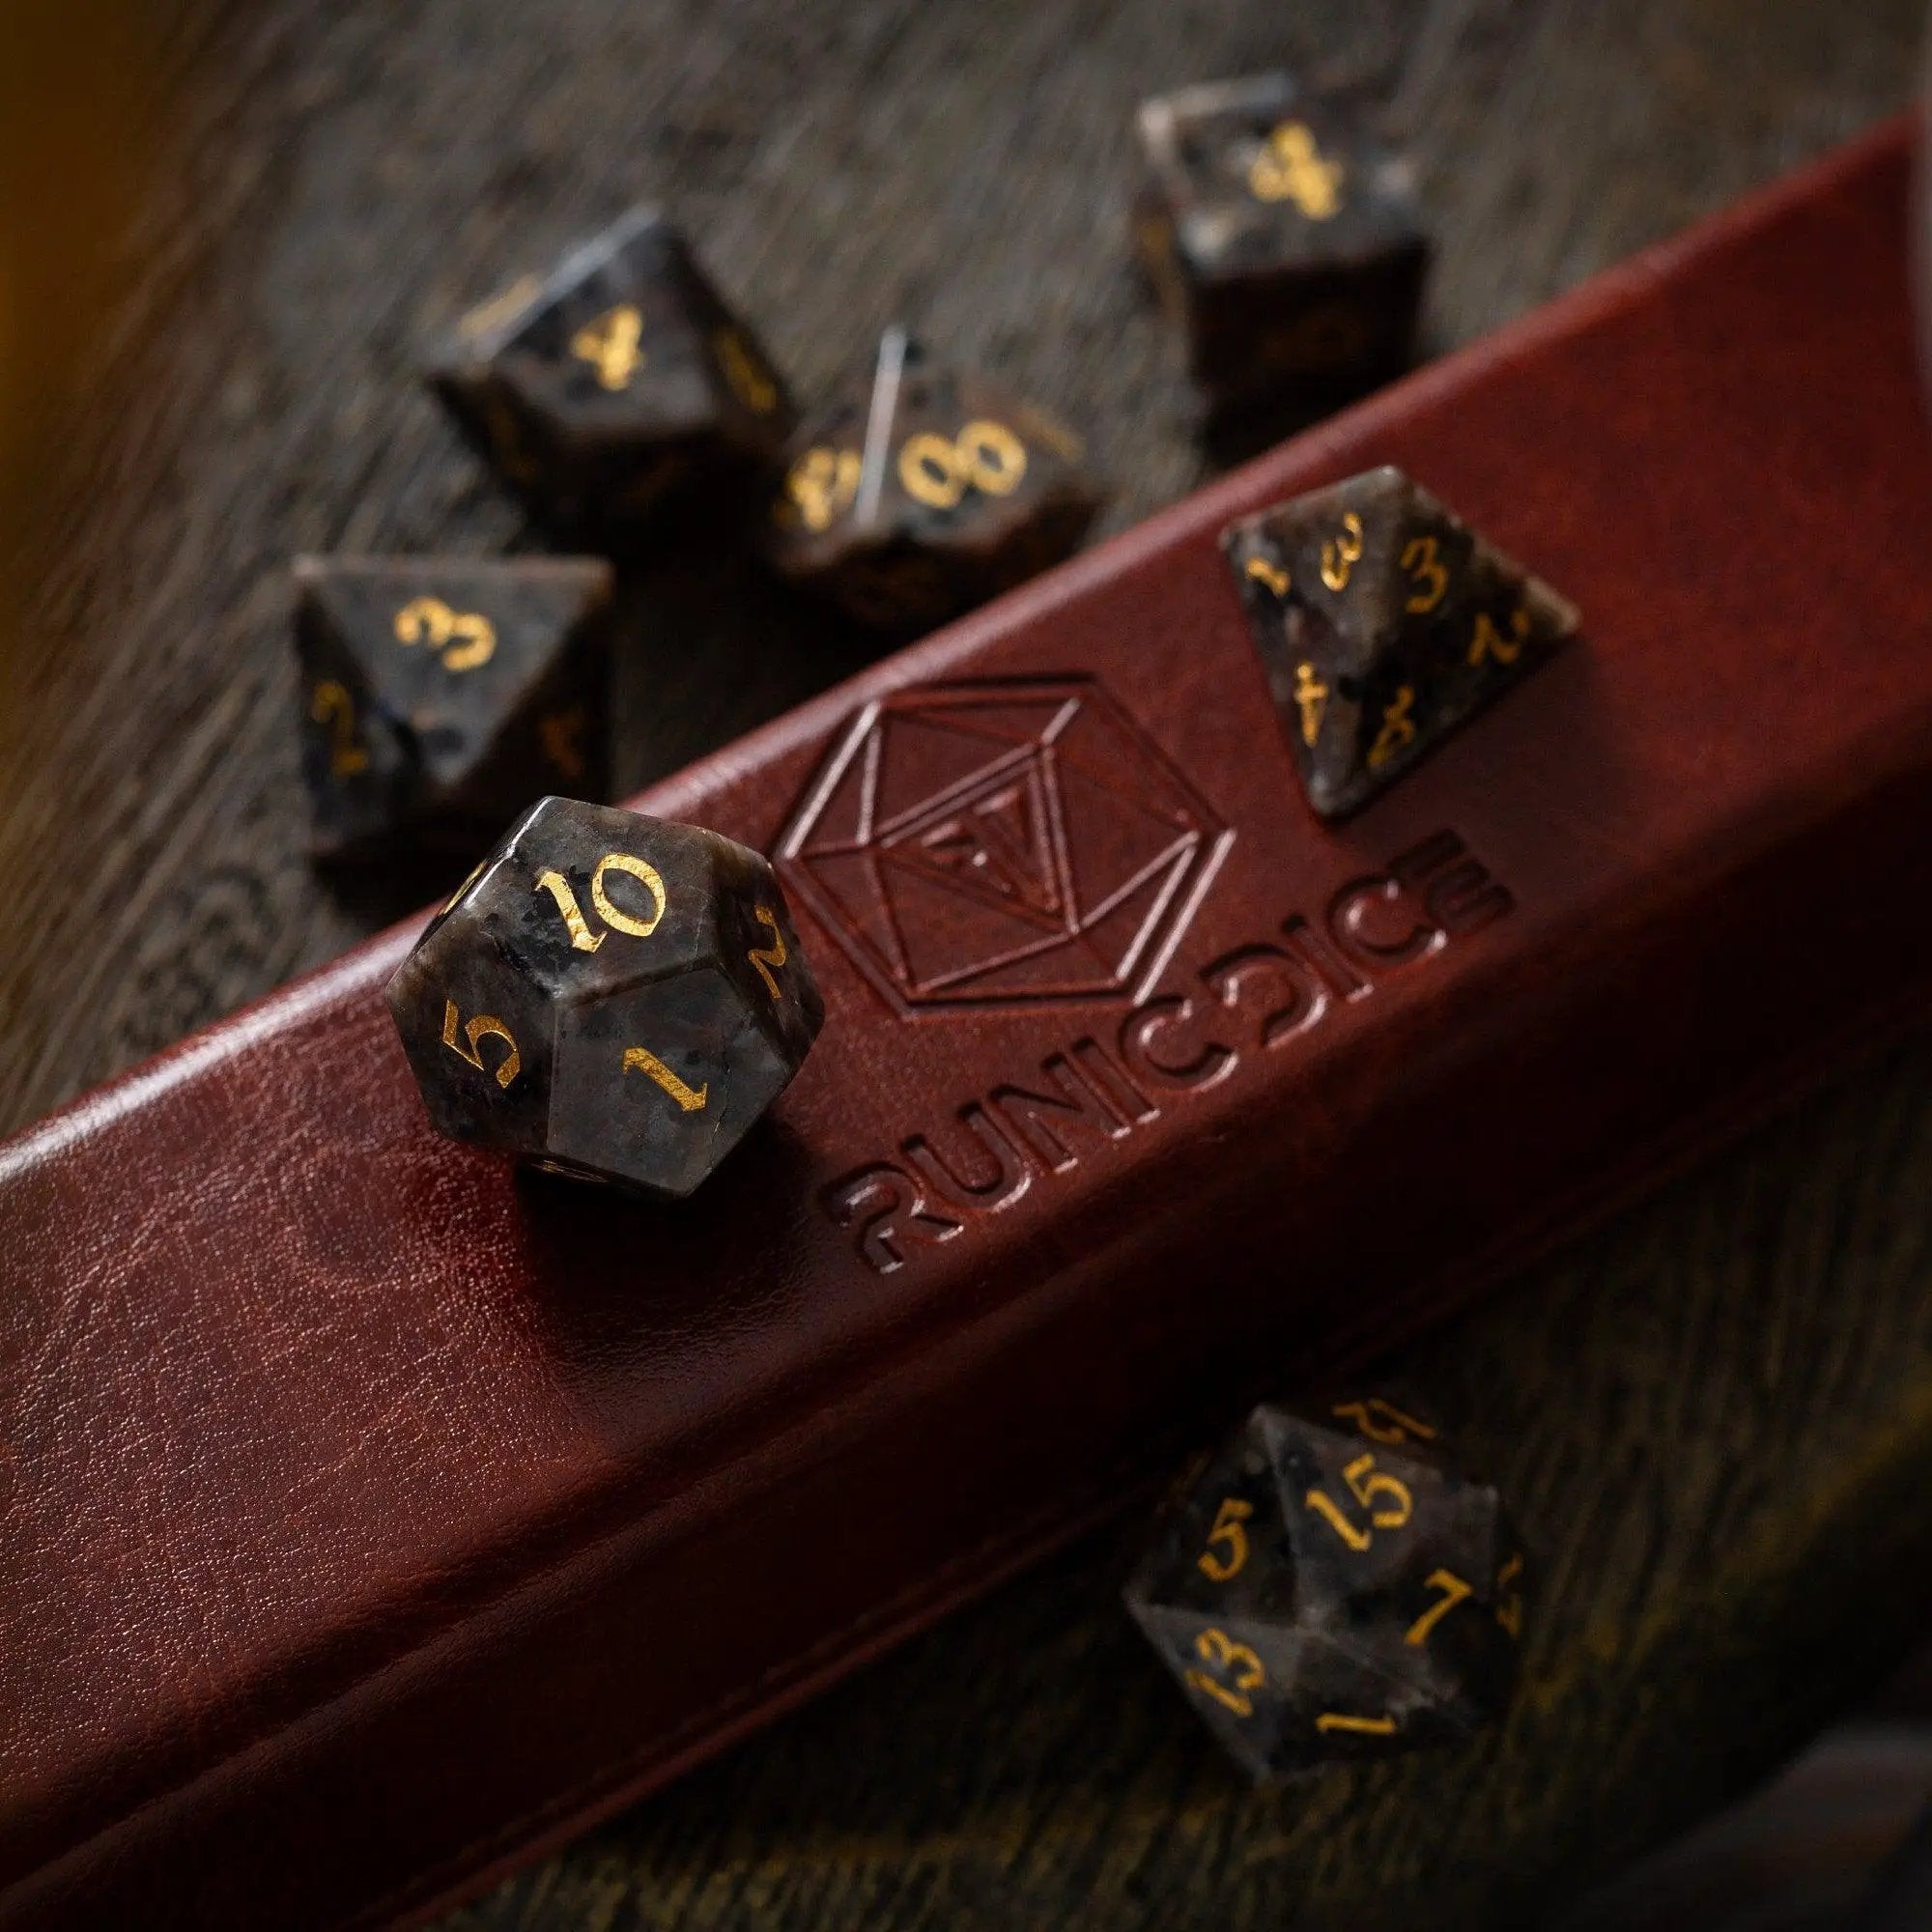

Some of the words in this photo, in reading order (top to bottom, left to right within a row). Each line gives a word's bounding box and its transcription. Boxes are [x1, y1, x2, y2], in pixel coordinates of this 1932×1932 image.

[897, 419, 1027, 509] 00
[1321, 512, 1363, 592] 3
[1400, 535, 1448, 615] 3
[394, 595, 498, 672] 3
[1467, 609, 1530, 666] 2
[533, 852, 667, 954] 10
[747, 904, 788, 1000] 2
[440, 997, 522, 1090] 5
[621, 1044, 709, 1114] 1
[1196, 1496, 1254, 1583] 5
[1304, 1452, 1414, 1553] 15
[1404, 1567, 1476, 1646] 7
[1183, 1627, 1266, 1719] 13
[1314, 1710, 1398, 1737] 1
